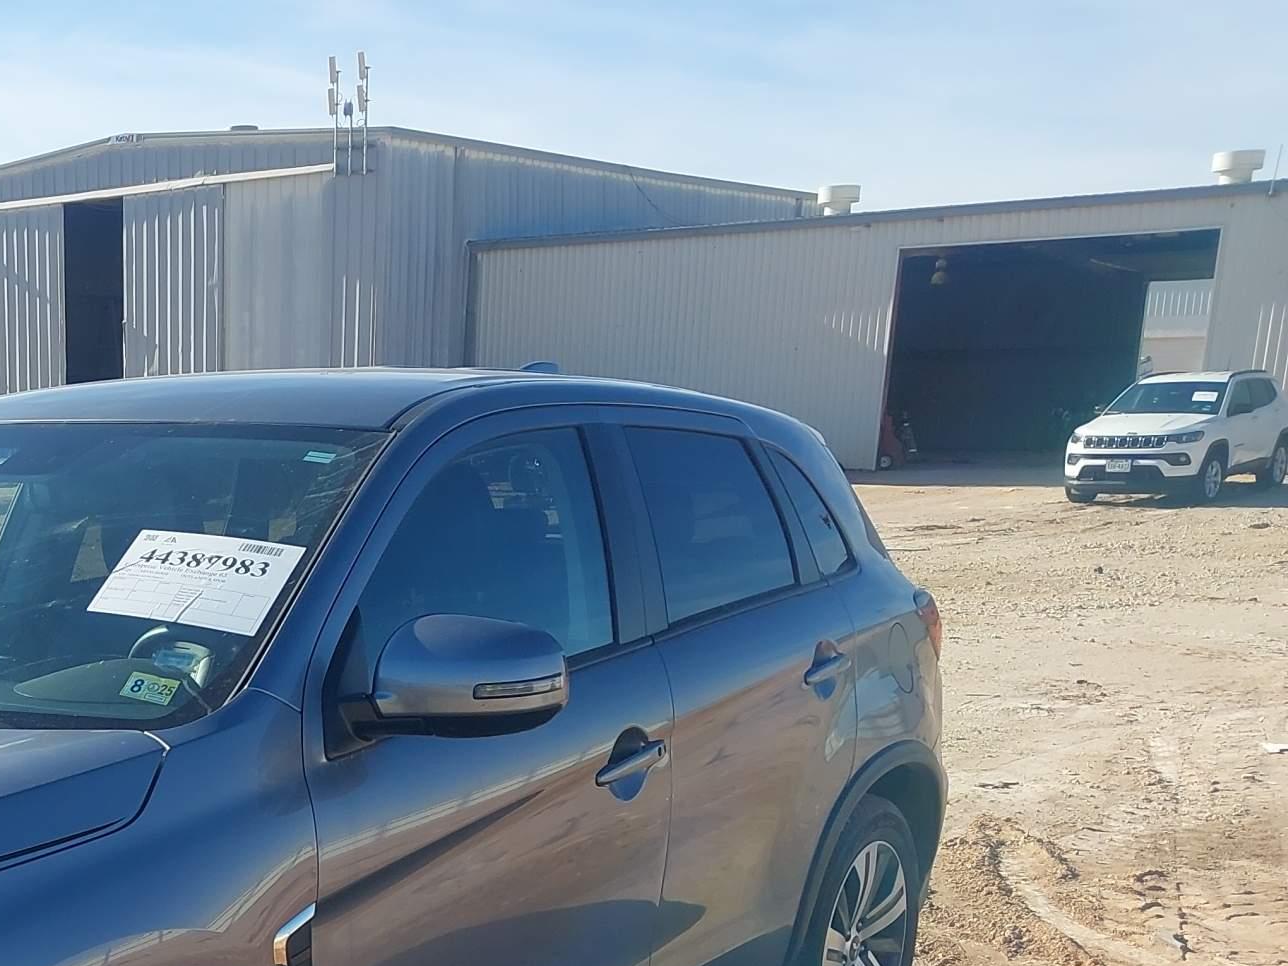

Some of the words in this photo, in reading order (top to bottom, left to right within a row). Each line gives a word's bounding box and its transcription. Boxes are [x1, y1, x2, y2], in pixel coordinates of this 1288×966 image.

[139, 548, 271, 578] 44387983
[130, 679, 145, 693] 8
[157, 684, 176, 697] 25
